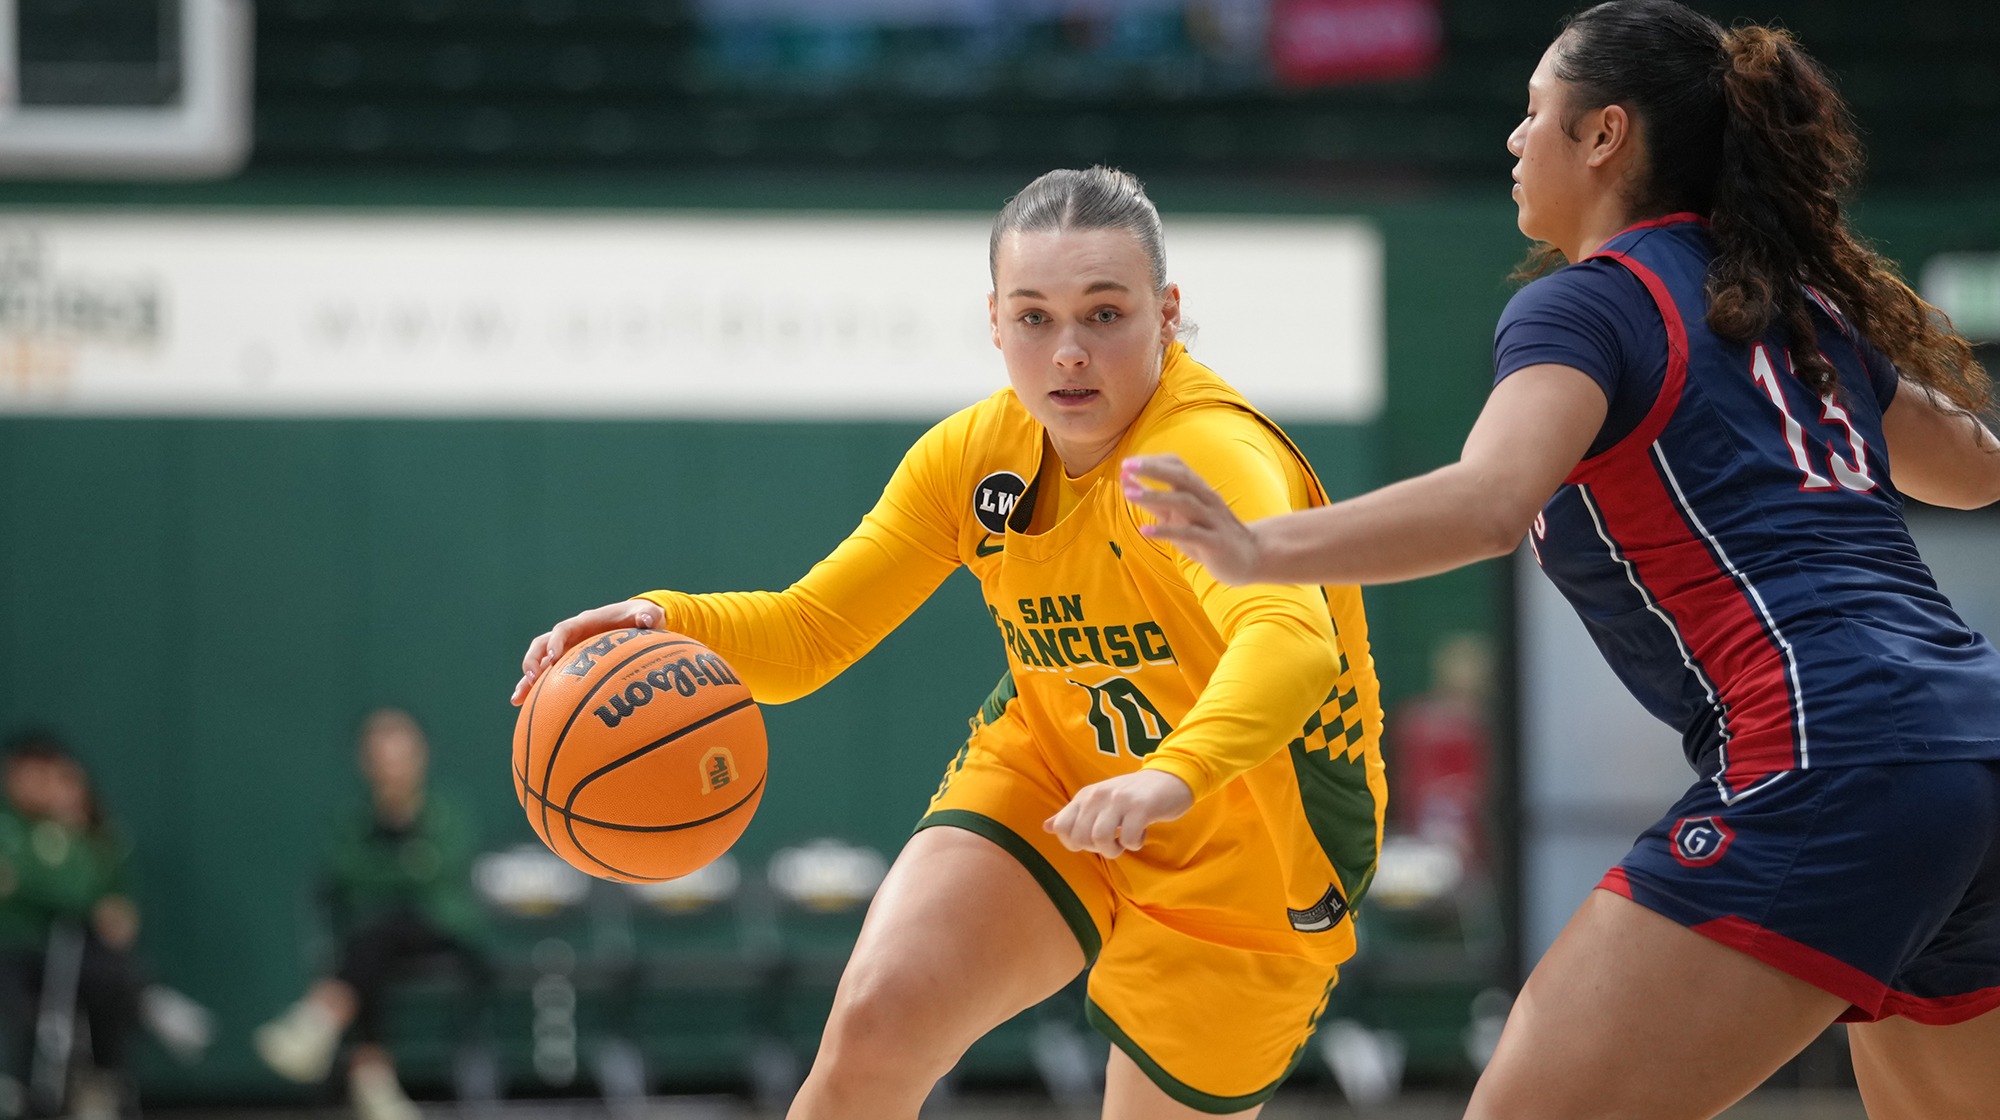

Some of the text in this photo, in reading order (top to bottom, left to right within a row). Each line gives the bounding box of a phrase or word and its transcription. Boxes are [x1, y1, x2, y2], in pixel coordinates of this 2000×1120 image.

[1750, 342, 1879, 494] 13
[989, 604, 1178, 667] RANCISC
[1018, 594, 1084, 624] SAN
[562, 628, 671, 677] CAA
[593, 652, 742, 729] Wilson
[1066, 676, 1174, 758] 10
[1684, 826, 1712, 854] G
